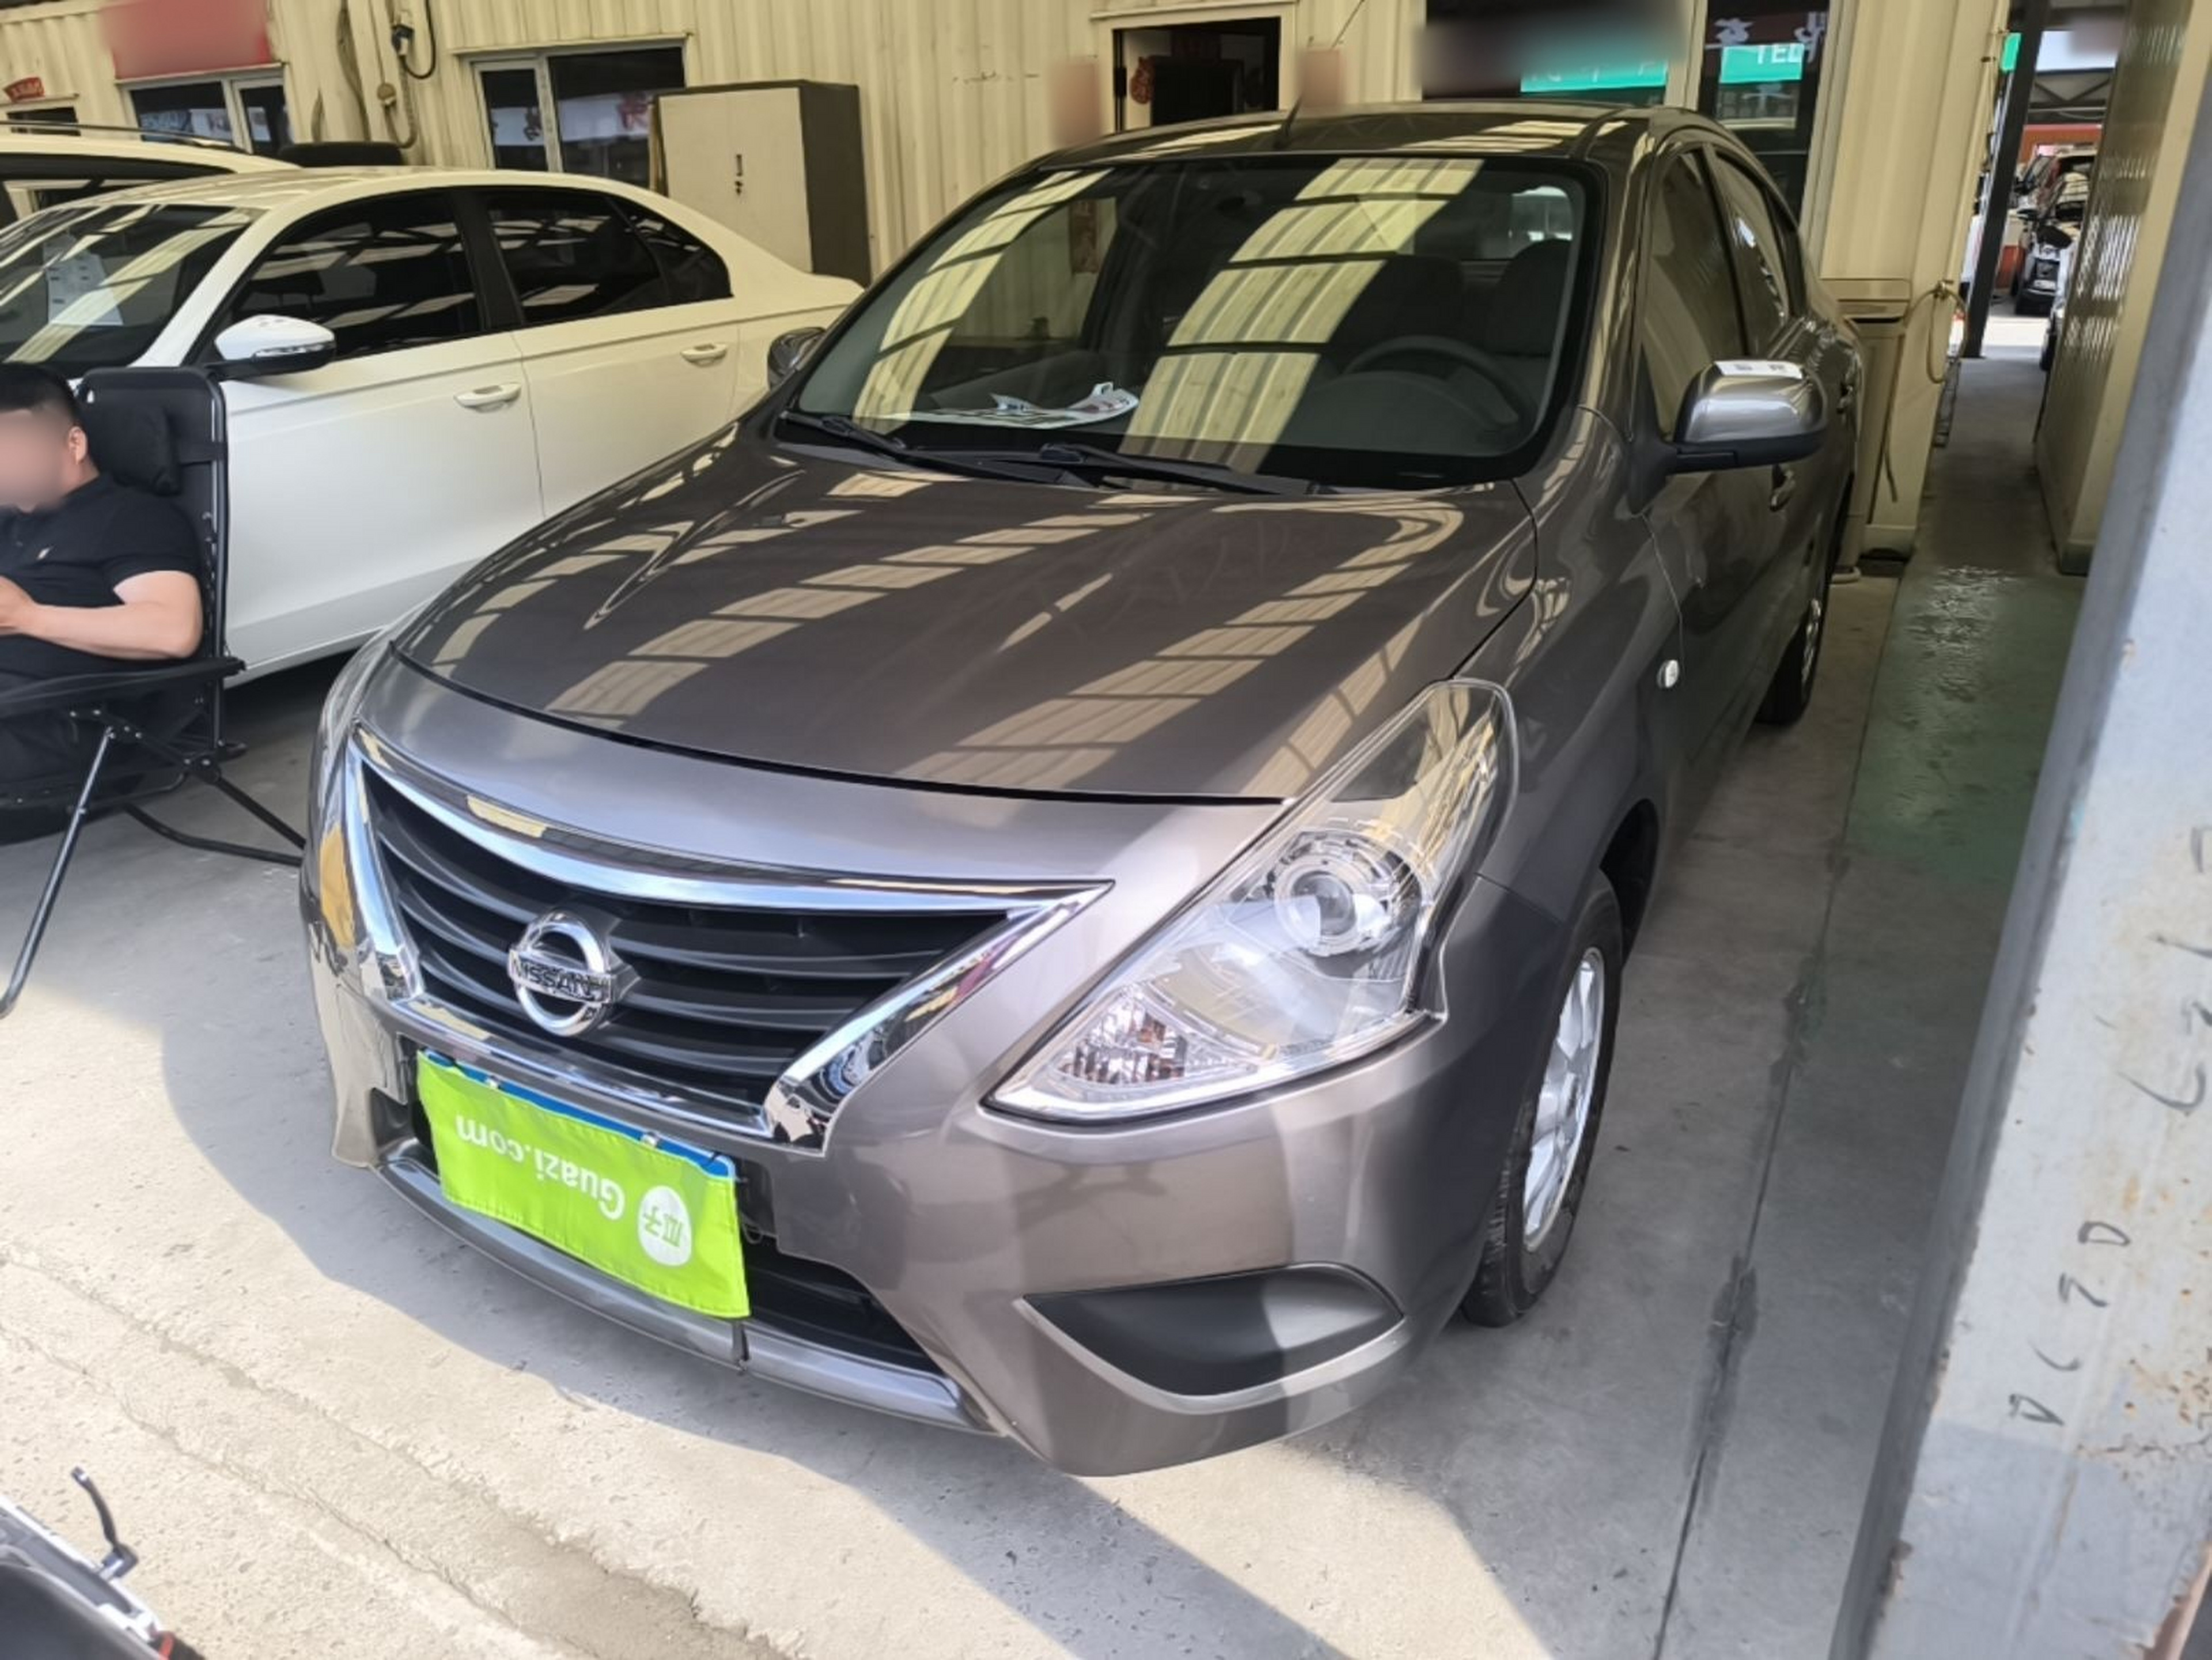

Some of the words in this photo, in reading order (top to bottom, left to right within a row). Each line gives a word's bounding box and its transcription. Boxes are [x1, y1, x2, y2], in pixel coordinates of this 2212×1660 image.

[512, 954, 594, 1000] NISSAN
[456, 1116, 625, 1220] Guazi.com
[641, 1205, 684, 1249] 瓜子
